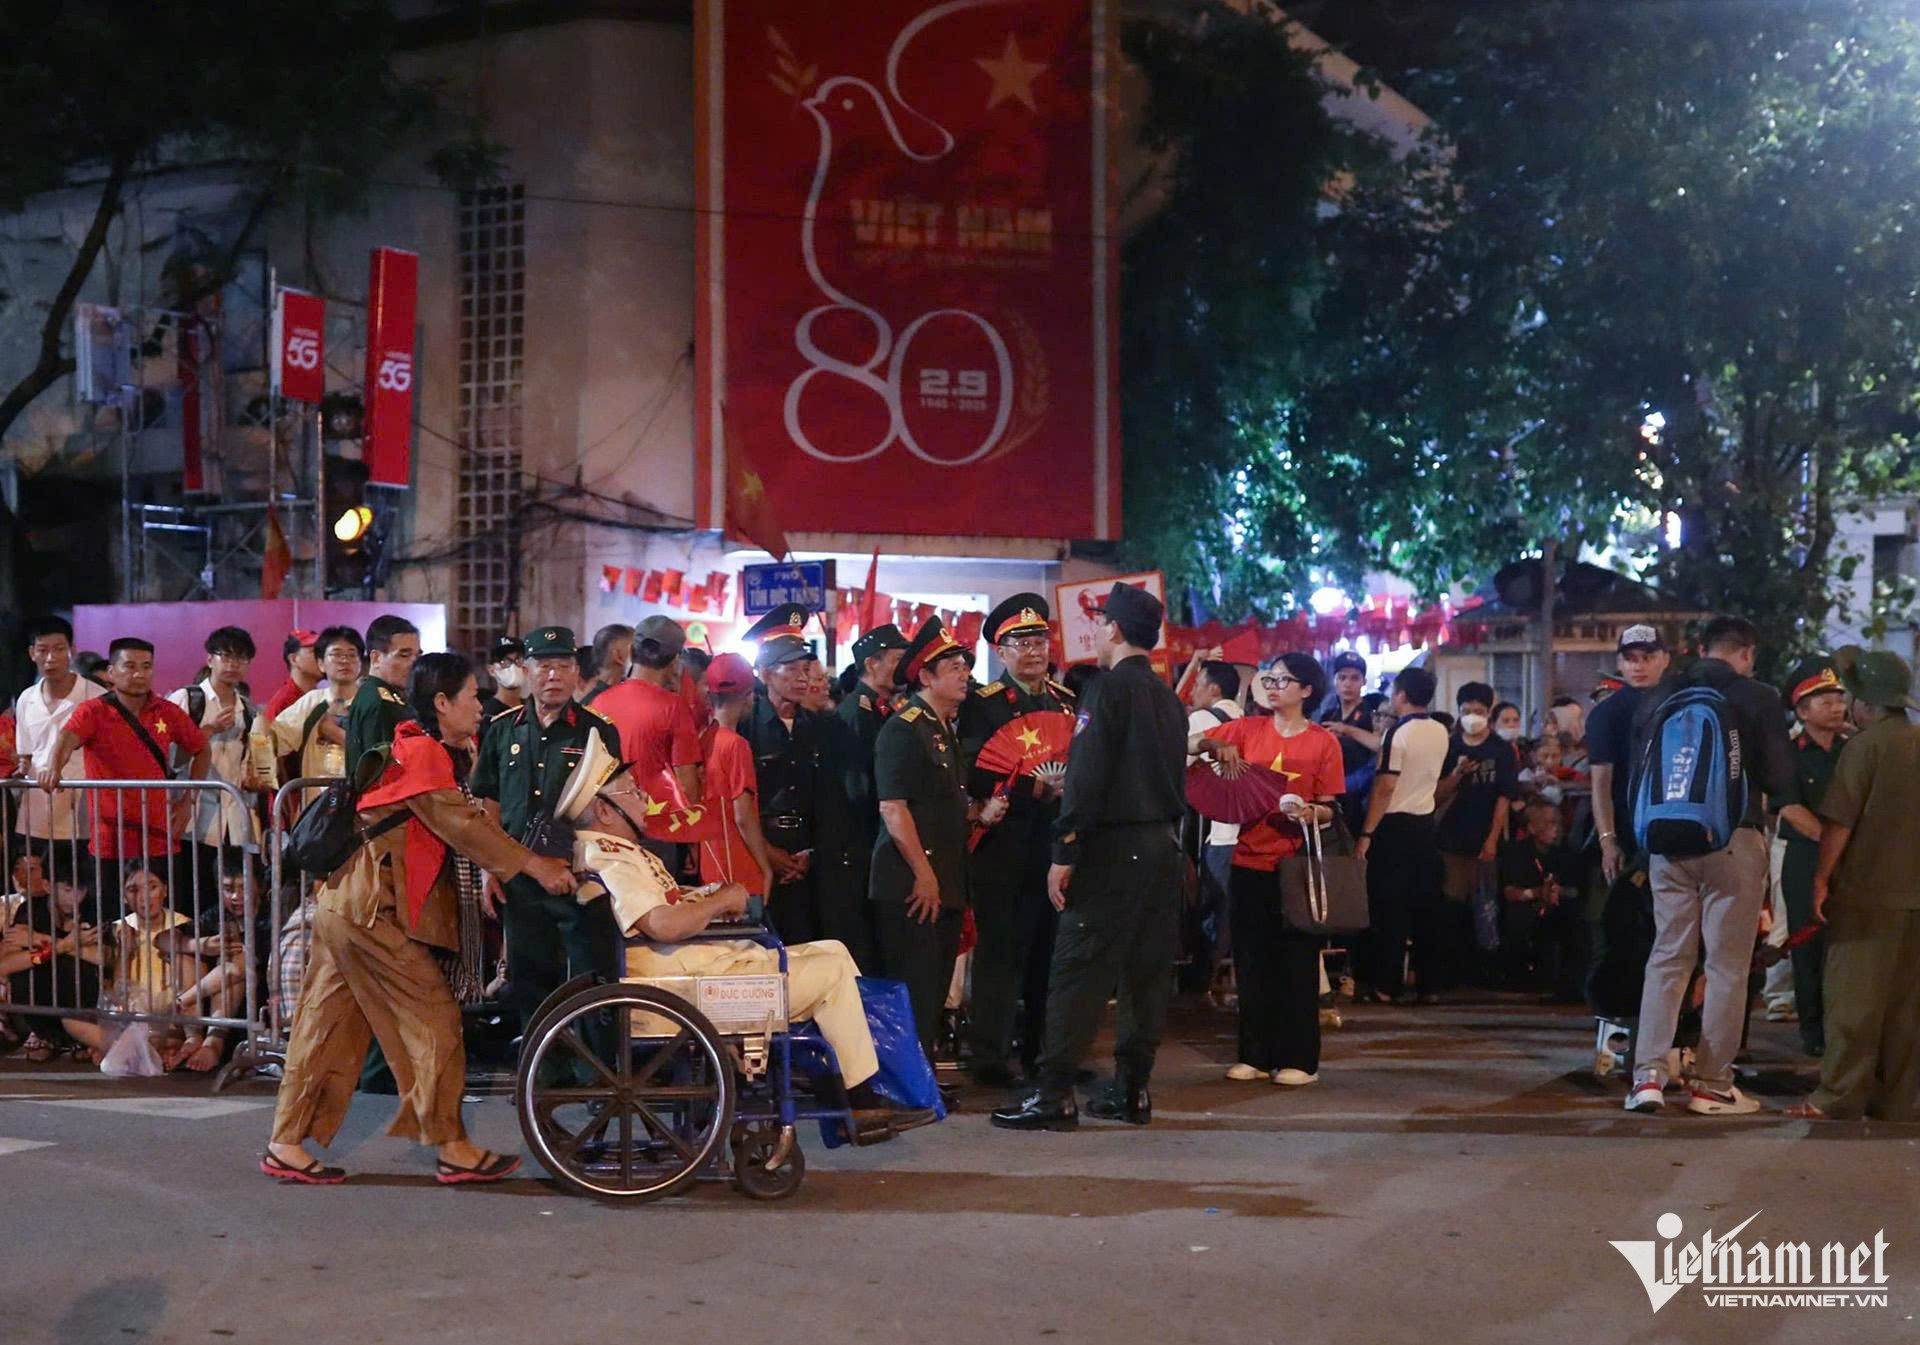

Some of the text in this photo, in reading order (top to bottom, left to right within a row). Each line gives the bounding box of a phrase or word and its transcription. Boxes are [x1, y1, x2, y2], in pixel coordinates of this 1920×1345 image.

[286, 336, 319, 370] 5G
[378, 359, 411, 392] 5G
[784, 305, 1014, 467] 80
[919, 368, 987, 396] 2.9
